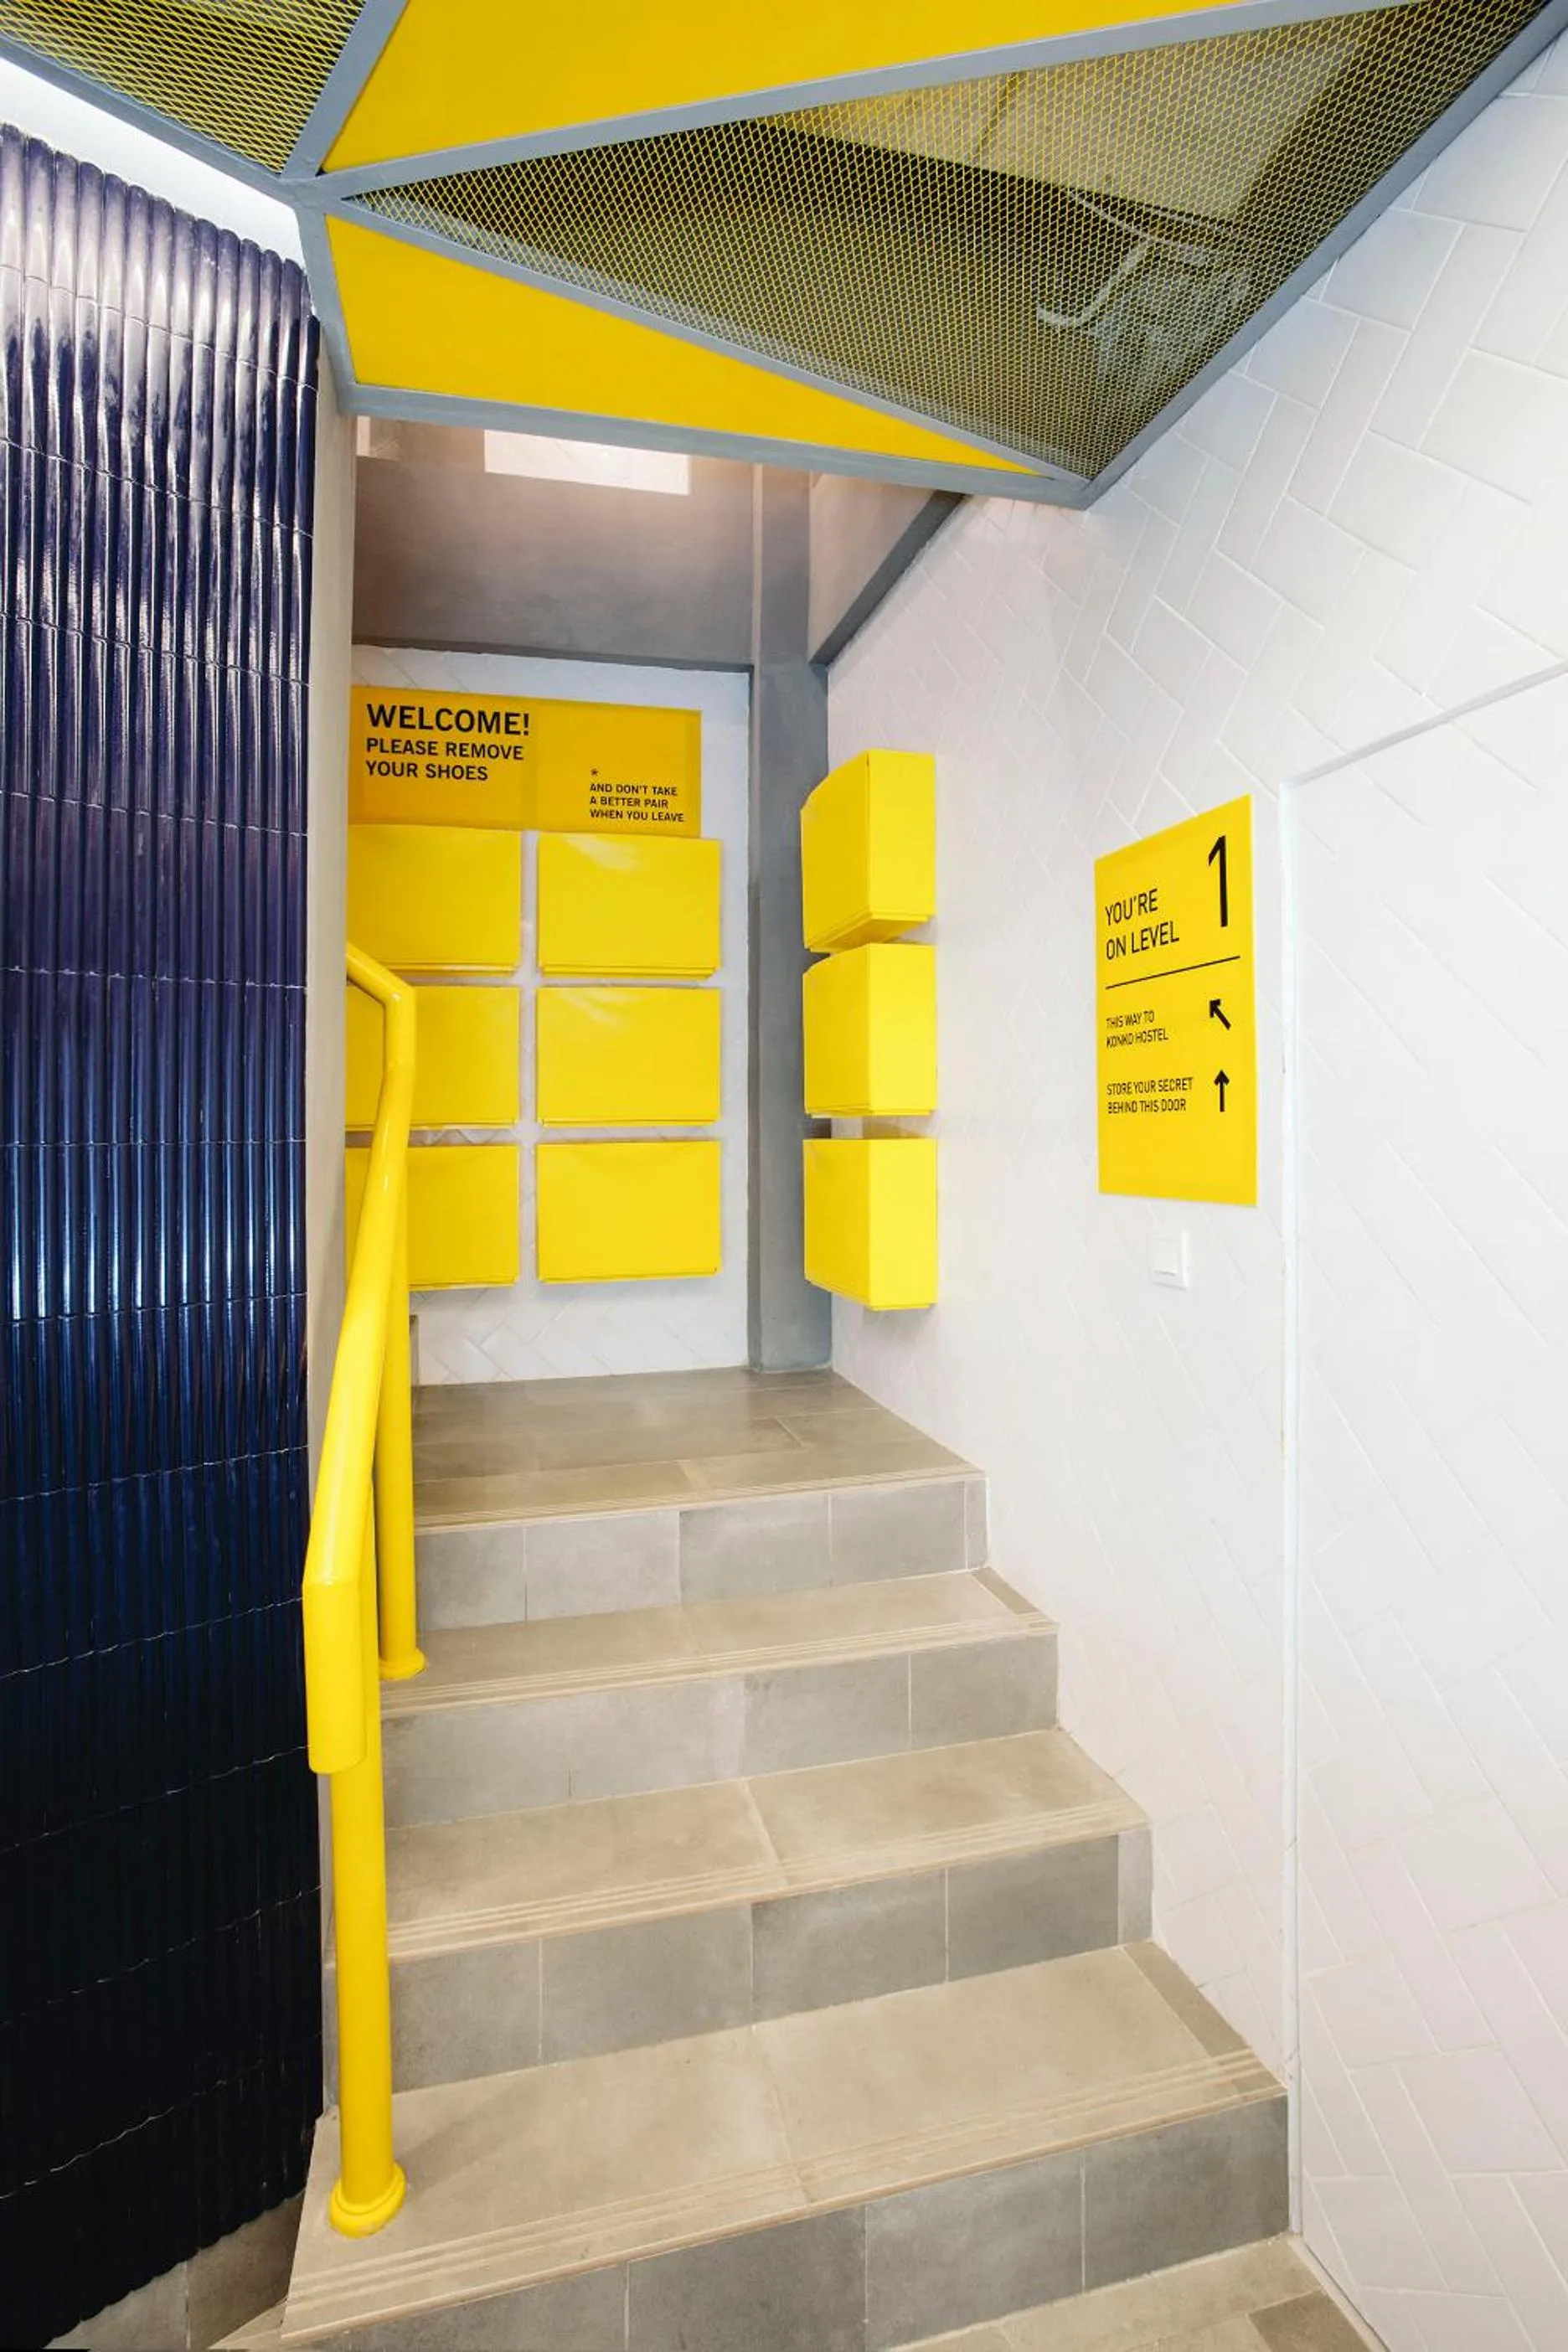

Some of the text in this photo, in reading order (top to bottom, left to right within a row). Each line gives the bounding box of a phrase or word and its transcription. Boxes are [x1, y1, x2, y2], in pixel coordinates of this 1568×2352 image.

[366, 703, 529, 736] WELCOME!
[366, 737, 524, 761] PLEASE REMOVE
[366, 760, 488, 781] YOUR SHOES
[589, 782, 678, 796] AND DON'T TAKE
[589, 796, 668, 808] A BETTER PAIR
[589, 808, 684, 823] WHEN YOU LEAVE
[1208, 835, 1229, 928] 1
[1105, 888, 1158, 926] YOU'RE
[1106, 921, 1180, 961] ON LEVEL
[1106, 1010, 1155, 1029] THIS WAY TO
[1136, 1028, 1169, 1044] HOSTEL
[1106, 1076, 1193, 1096] STORE YOUR SECRET
[1107, 1098, 1186, 1114] BEHIND THIS DOOR
